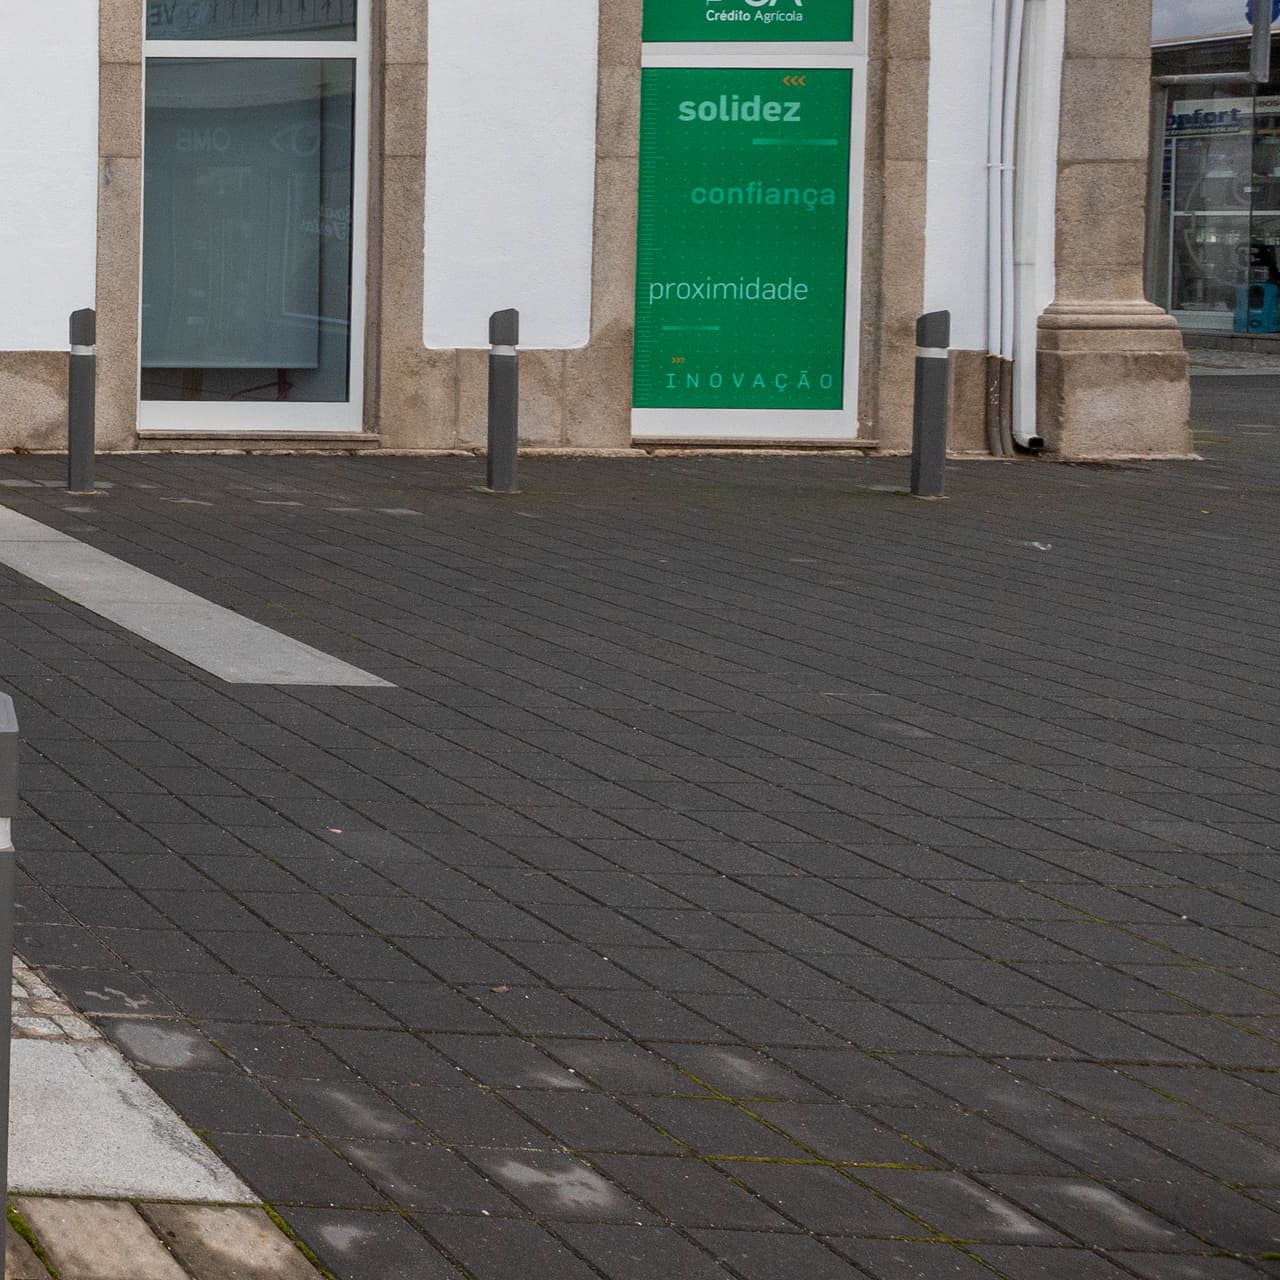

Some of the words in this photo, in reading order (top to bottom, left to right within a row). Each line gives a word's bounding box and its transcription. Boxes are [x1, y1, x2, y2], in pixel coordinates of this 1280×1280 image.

[706, 9, 751, 22] Crédito
[754, 9, 803, 24] Agrícola
[678, 94, 801, 121] solidez
[691, 181, 836, 211] confiança
[649, 276, 808, 304] proximidade
[665, 370, 833, 392] INOVAÇÃO
